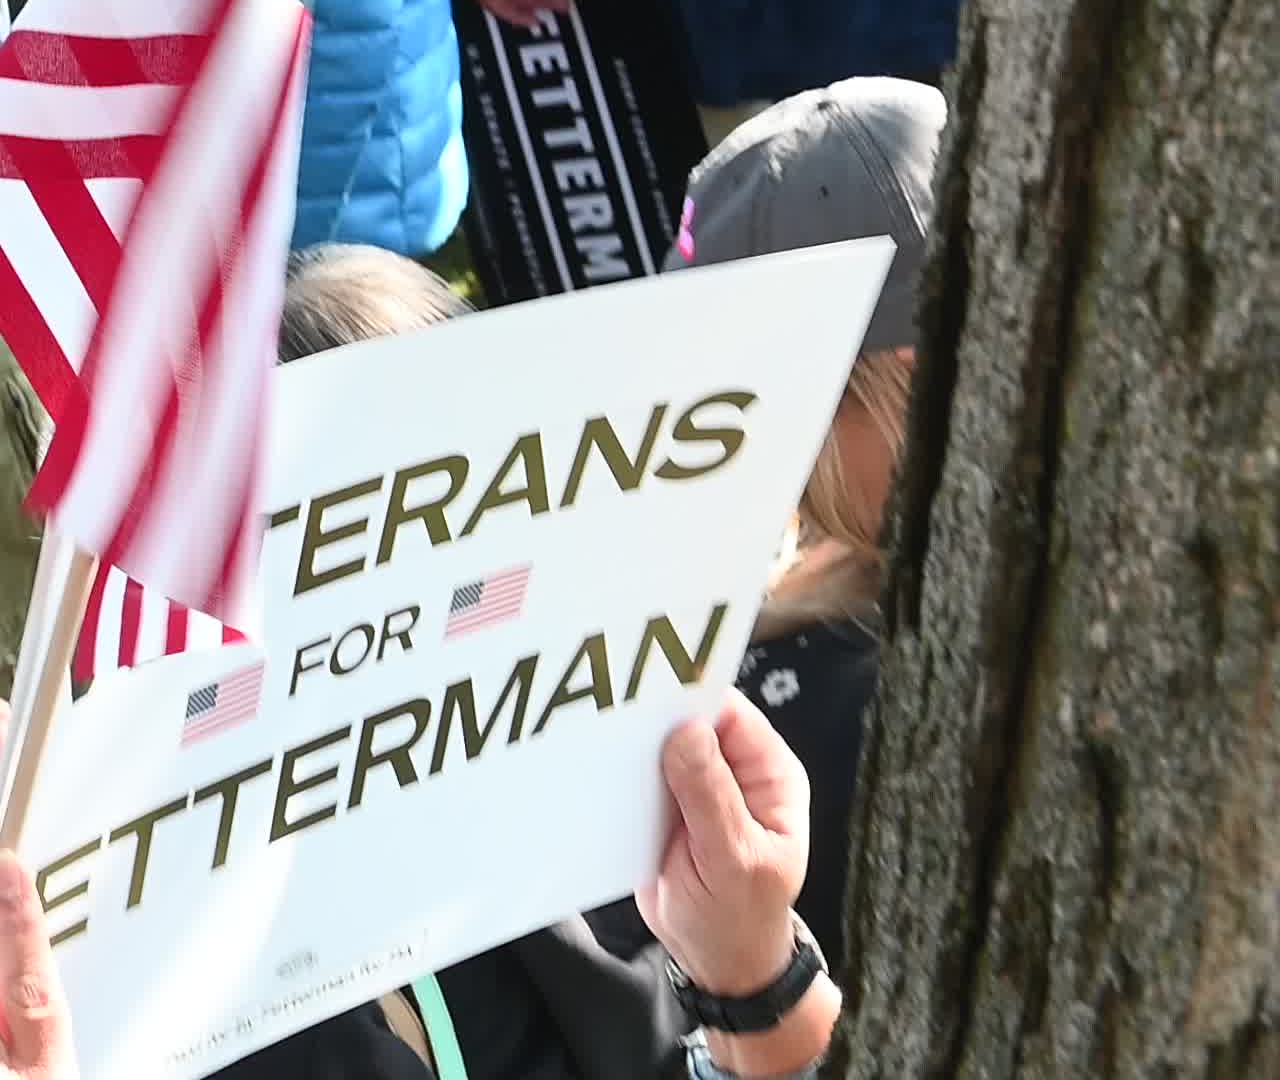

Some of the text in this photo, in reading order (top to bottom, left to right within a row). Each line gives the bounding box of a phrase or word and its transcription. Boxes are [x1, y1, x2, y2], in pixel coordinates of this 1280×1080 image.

[519, 8, 632, 281] FETTERM
[266, 390, 760, 598] ERANS
[288, 604, 422, 698] FOR
[35, 602, 730, 949] ETTERMAN
